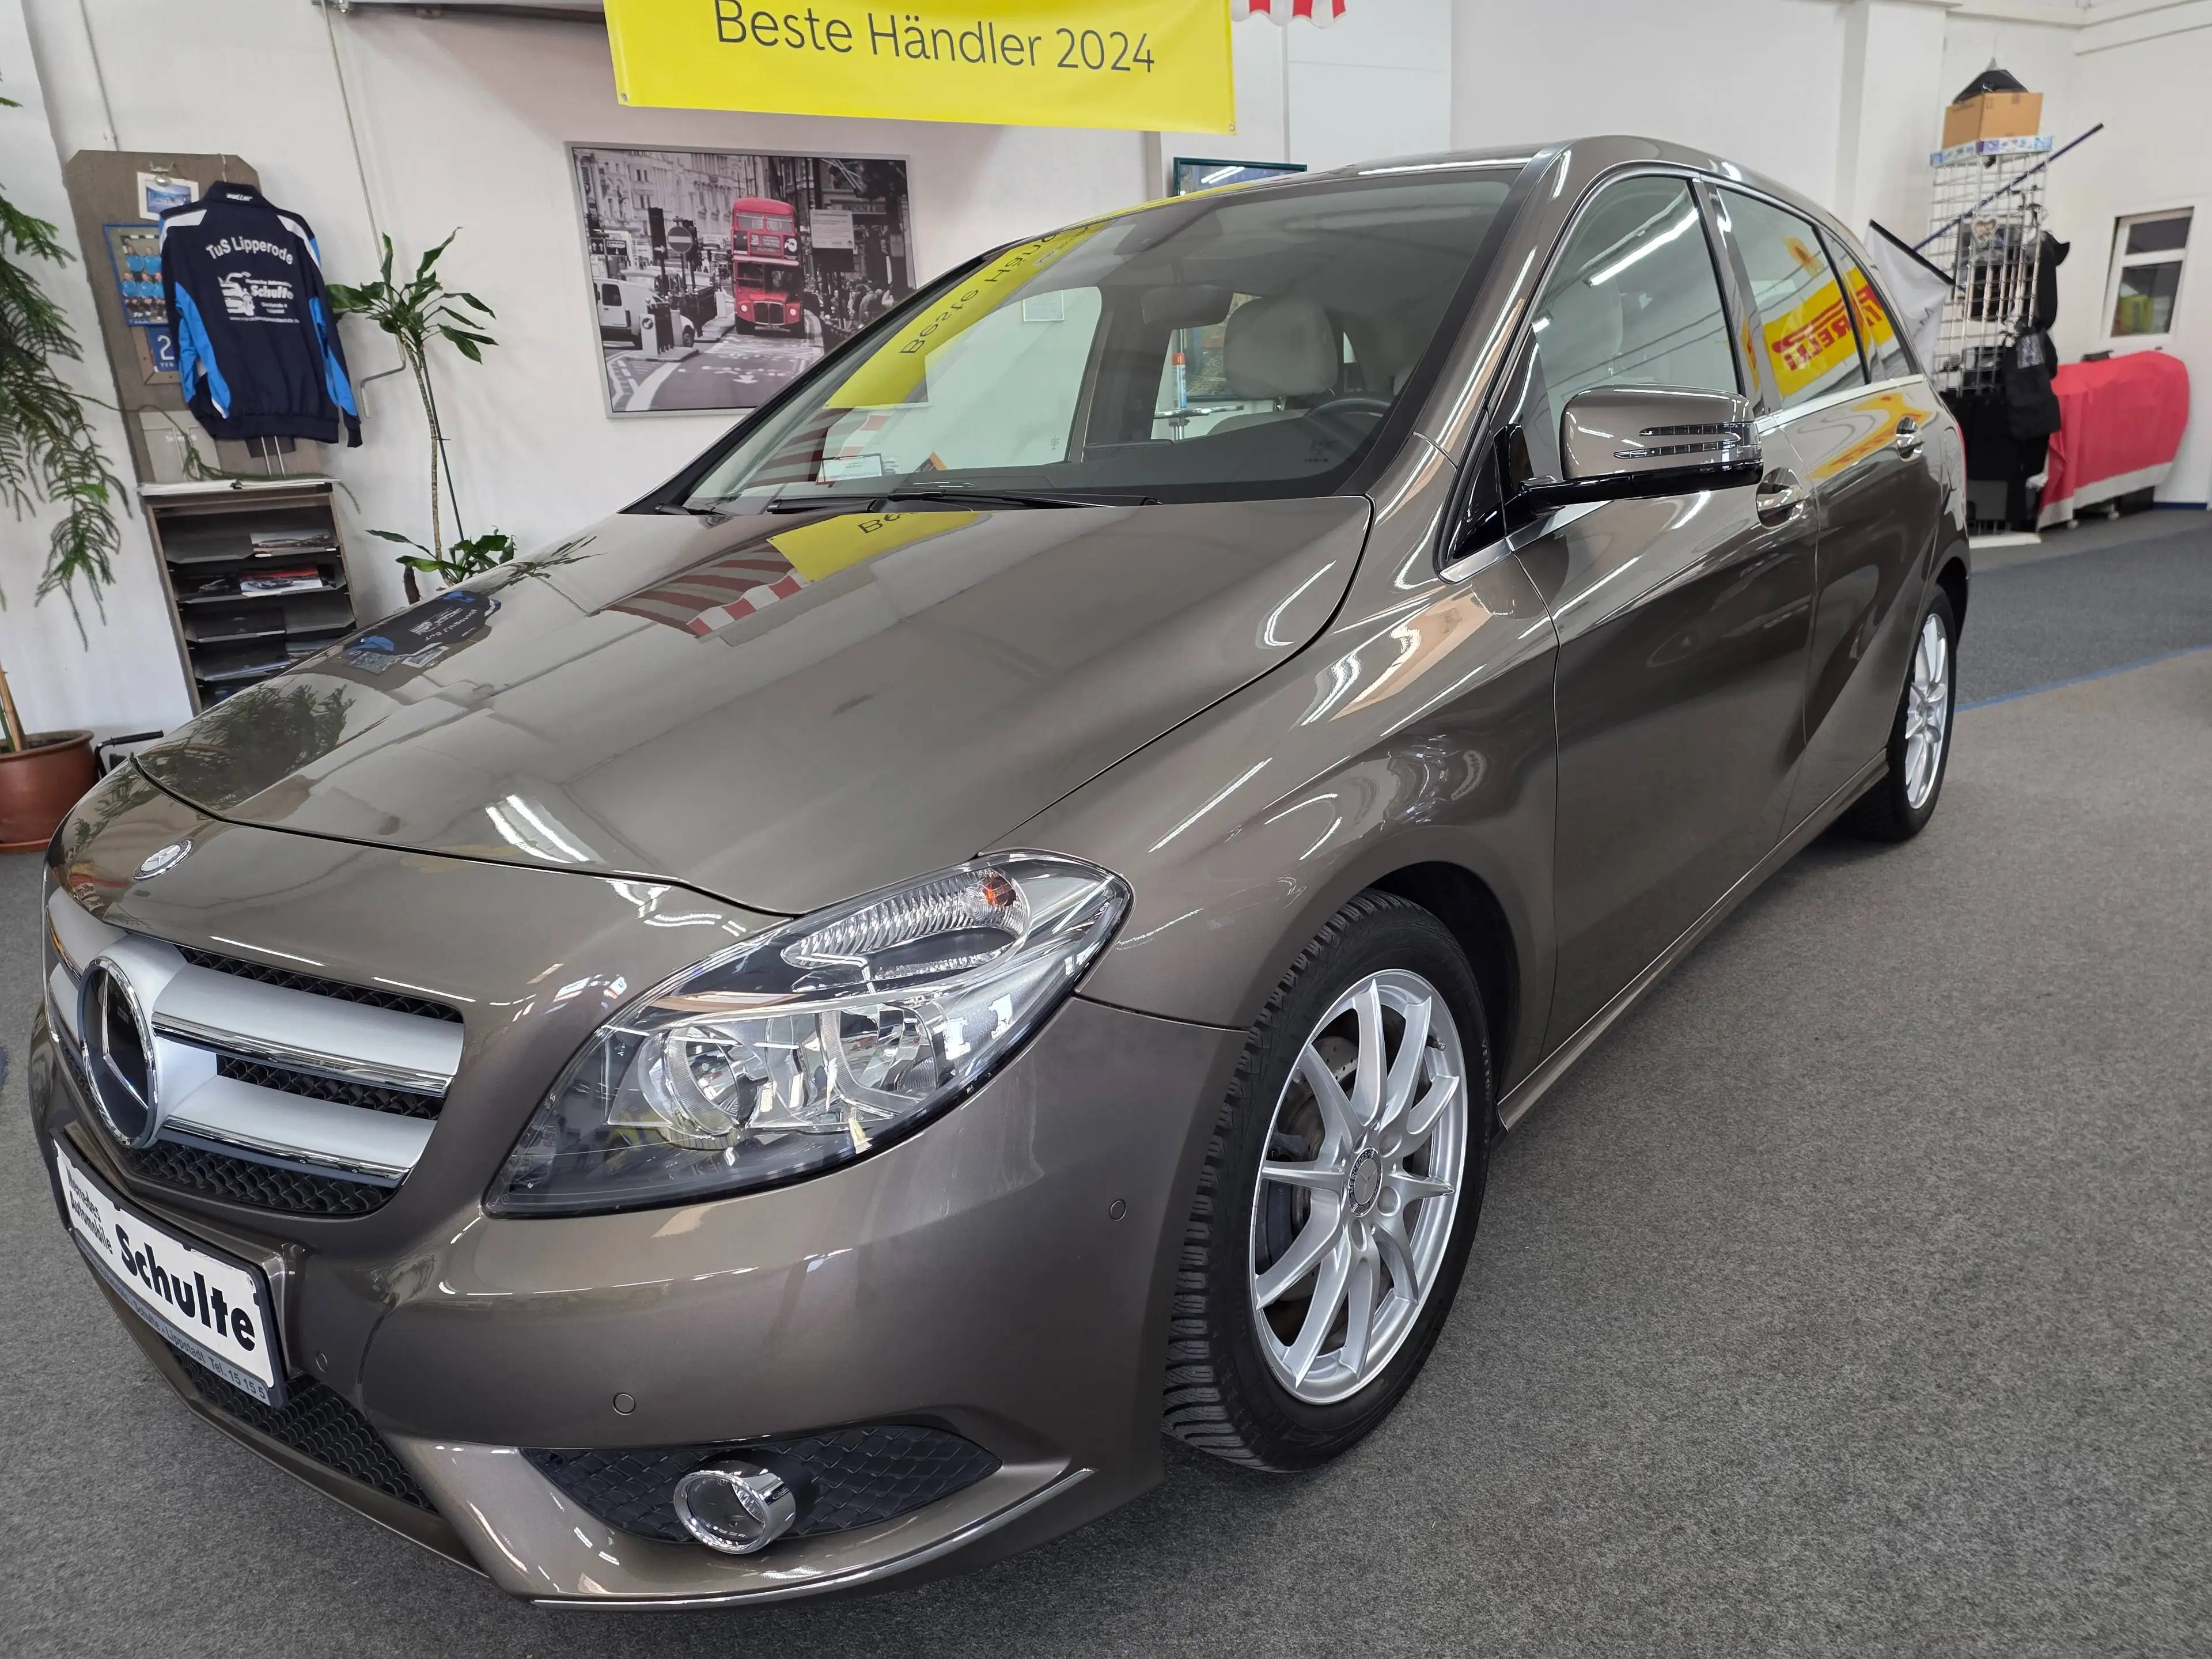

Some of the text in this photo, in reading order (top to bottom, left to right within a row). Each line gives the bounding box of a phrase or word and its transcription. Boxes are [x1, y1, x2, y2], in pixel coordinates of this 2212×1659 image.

[715, 0, 1155, 73] Beste Händler 2024
[205, 236, 293, 265] TuS Lipperode
[66, 1165, 101, 1223] Mercedes
[70, 1190, 113, 1255] Automobile
[115, 1224, 256, 1351] Schulte
[165, 1326, 206, 1364] Lippstadt
[208, 1357, 227, 1377] Tel.
[228, 1370, 241, 1385] 15
[243, 1378, 257, 1395] 15
[257, 1387, 266, 1400] 5
